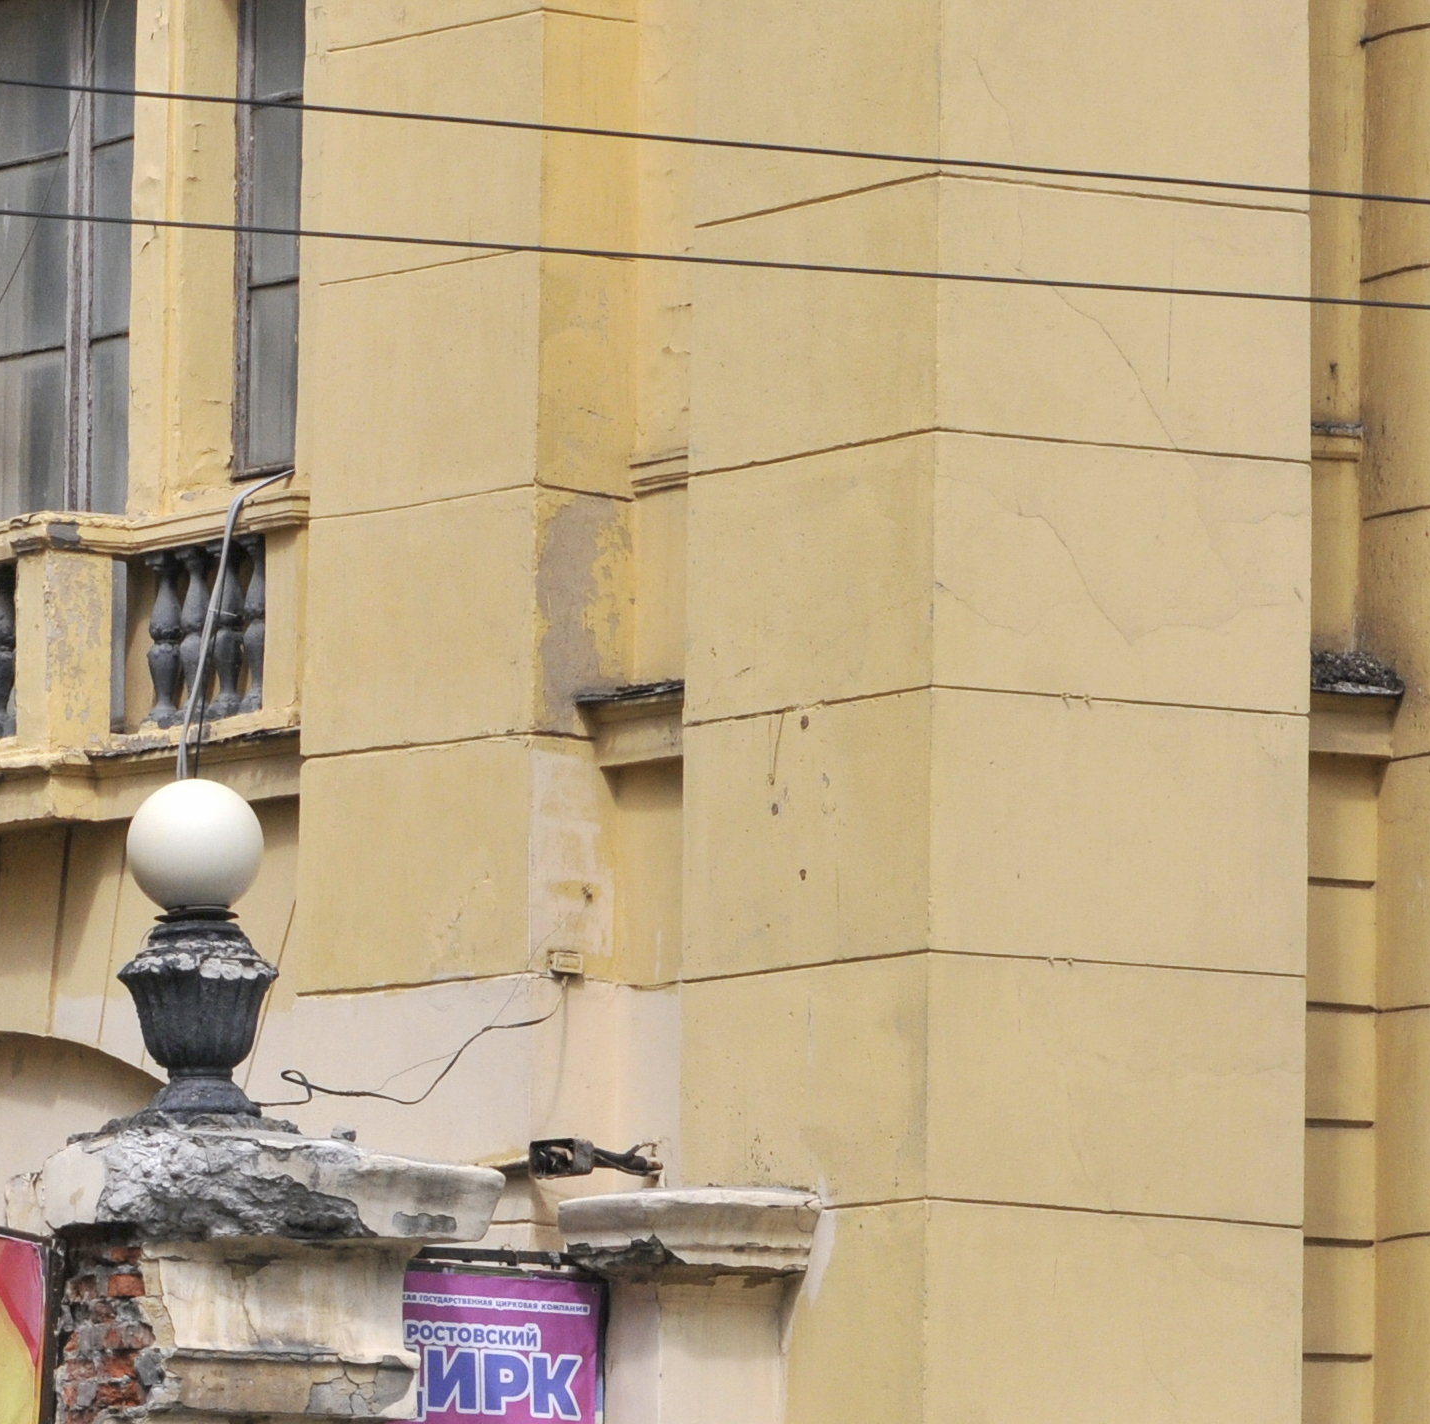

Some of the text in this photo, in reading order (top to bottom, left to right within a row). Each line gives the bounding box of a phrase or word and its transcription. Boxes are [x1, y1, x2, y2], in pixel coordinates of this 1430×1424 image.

[419, 1294, 493, 1308] ГОСУДАРСТВЕННАЯ
[495, 1299, 539, 1311] ЦИРКОВАЯ
[541, 1303, 589, 1314] КОМПАНИЯ
[406, 1323, 538, 1347] РОСТОВСКИЙ
[410, 1348, 581, 1418] ИРК
